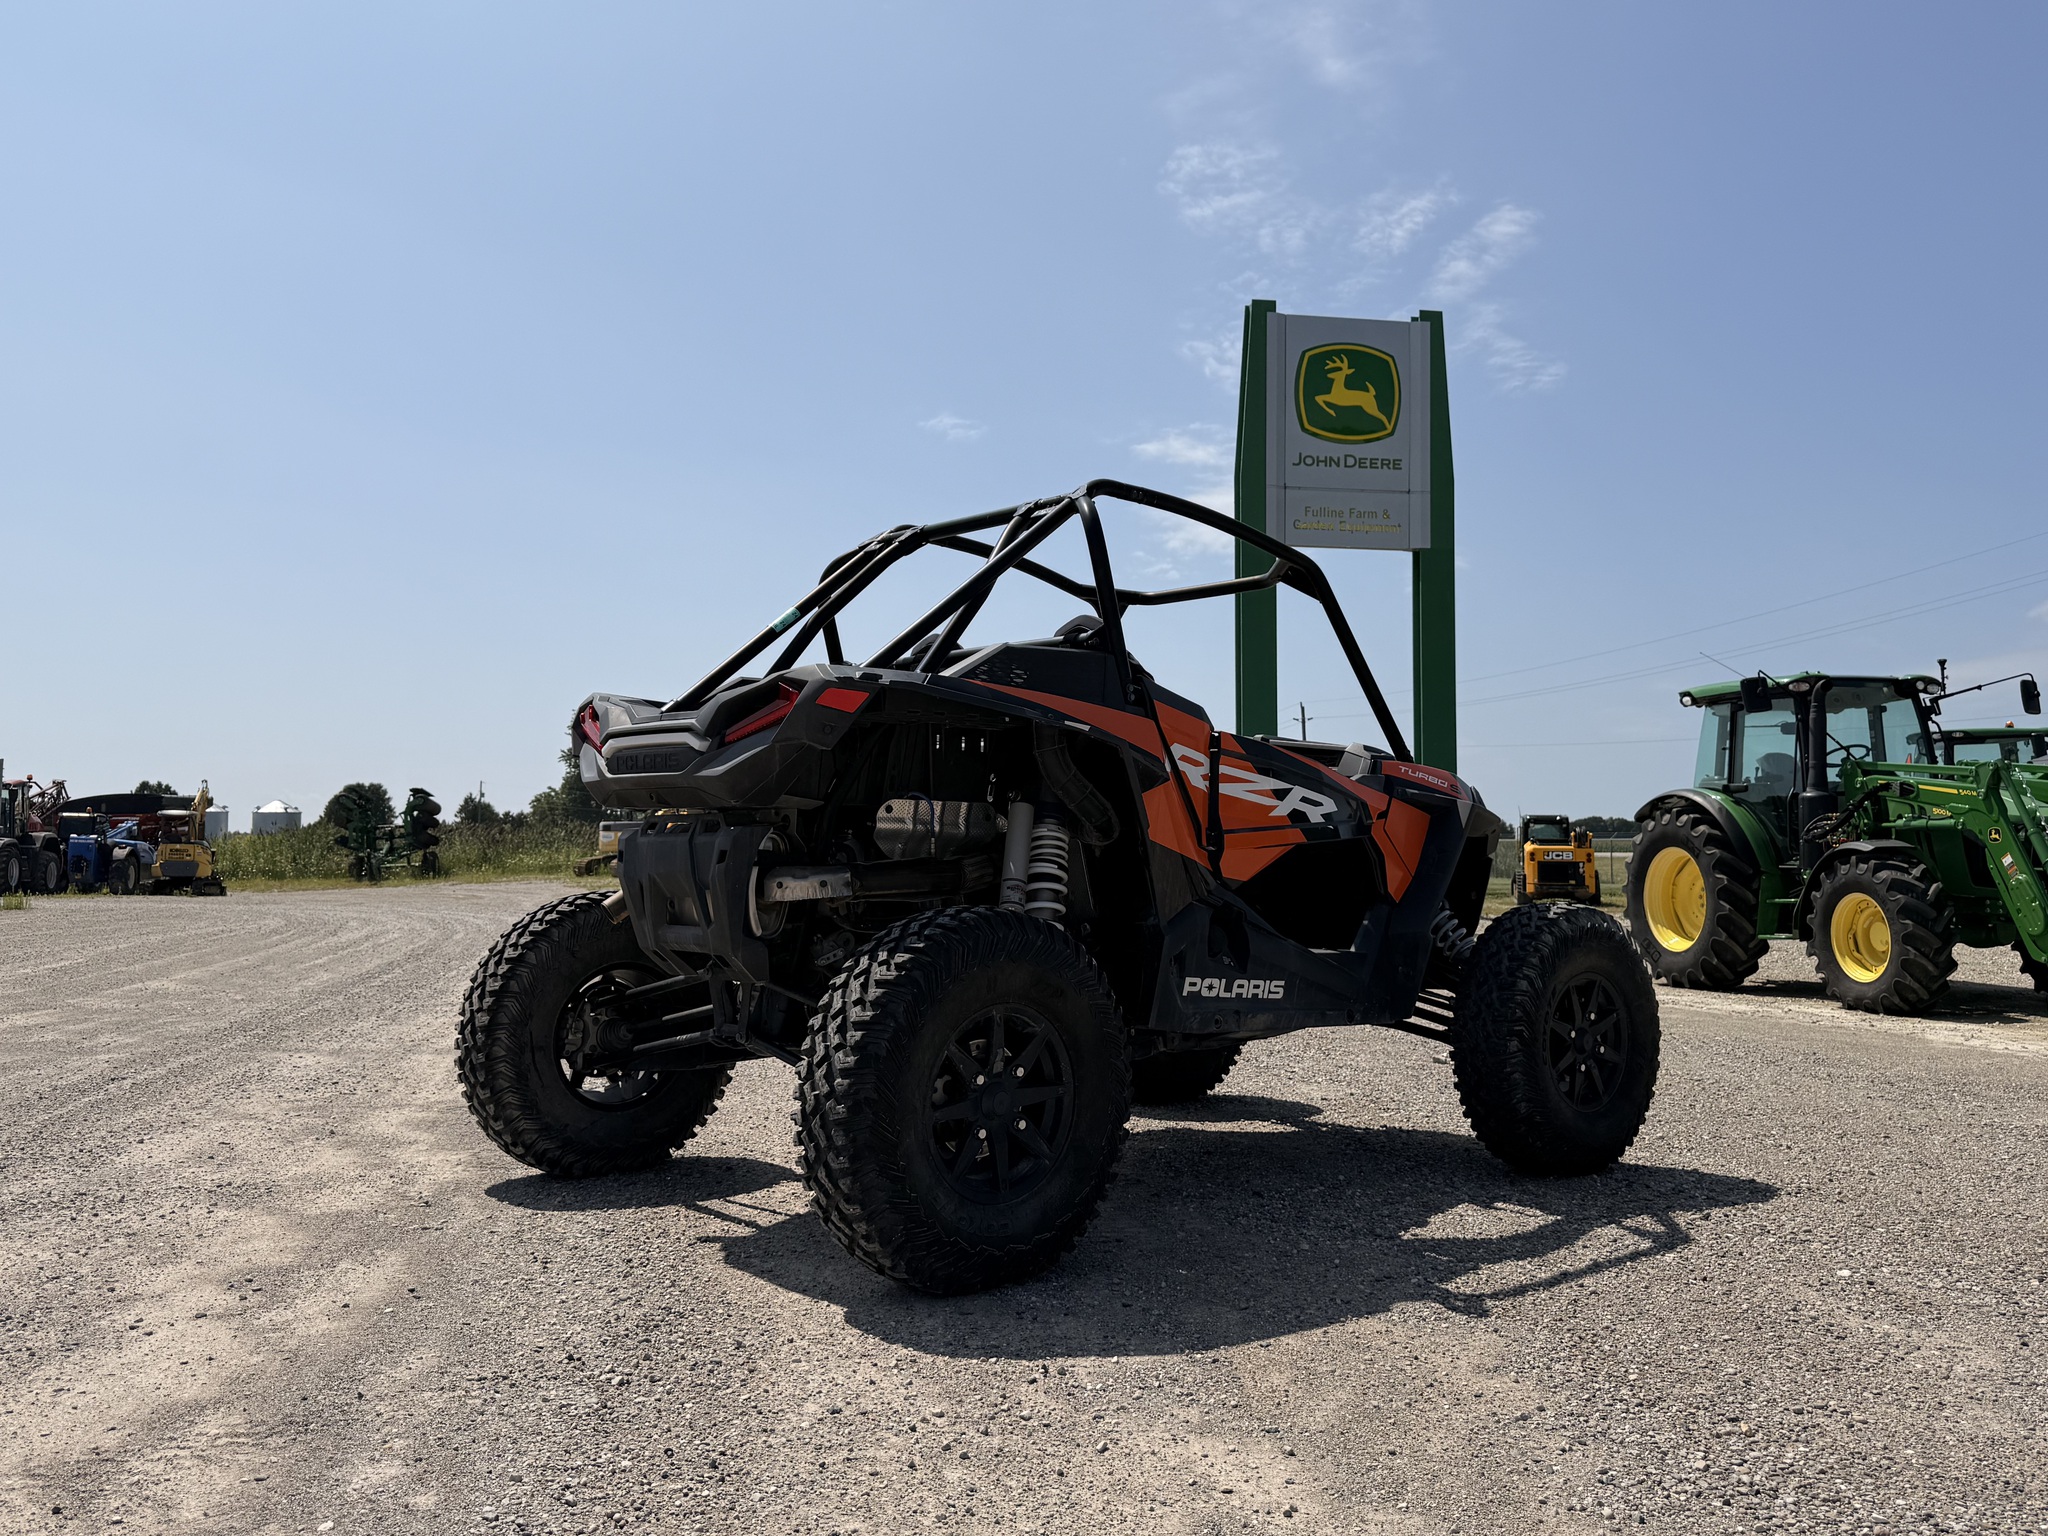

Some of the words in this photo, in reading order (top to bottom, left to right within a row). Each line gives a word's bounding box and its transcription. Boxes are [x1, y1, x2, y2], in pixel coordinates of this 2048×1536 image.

[1292, 452, 1340, 468] JOHN
[1344, 454, 1403, 470] DEERE
[1304, 506, 1345, 519] Fulline
[1349, 507, 1378, 519] Farm
[1382, 508, 1391, 520] &
[1293, 519, 1335, 531] Garden
[1339, 521, 1402, 534] Equipment
[1164, 742, 1338, 823] RZR
[1399, 765, 1448, 788] TURBO
[1450, 783, 1462, 795] S
[1544, 851, 1573, 860] JCB
[1182, 976, 1286, 999] POLARIS
